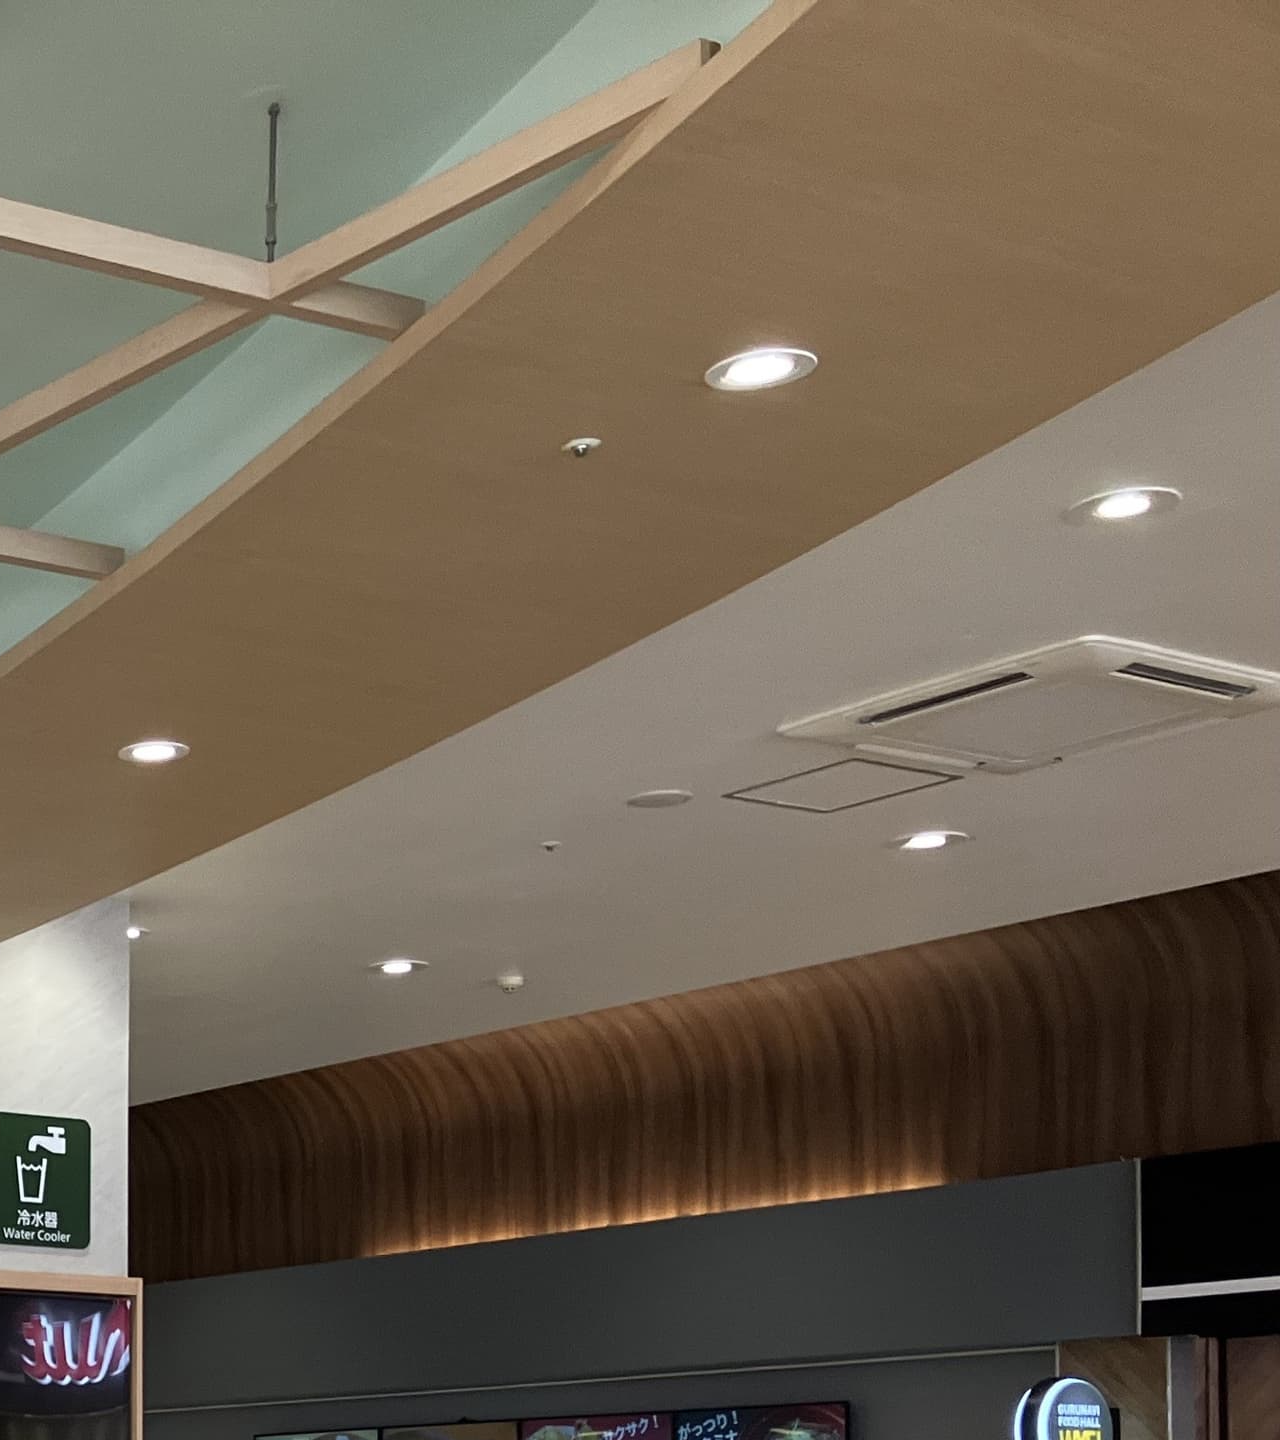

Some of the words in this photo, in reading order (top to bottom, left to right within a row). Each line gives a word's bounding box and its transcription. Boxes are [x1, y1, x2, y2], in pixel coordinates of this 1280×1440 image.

[17, 1209, 58, 1229] 冷水器
[3, 1227, 35, 1240] Water
[37, 1229, 71, 1243] Cooler
